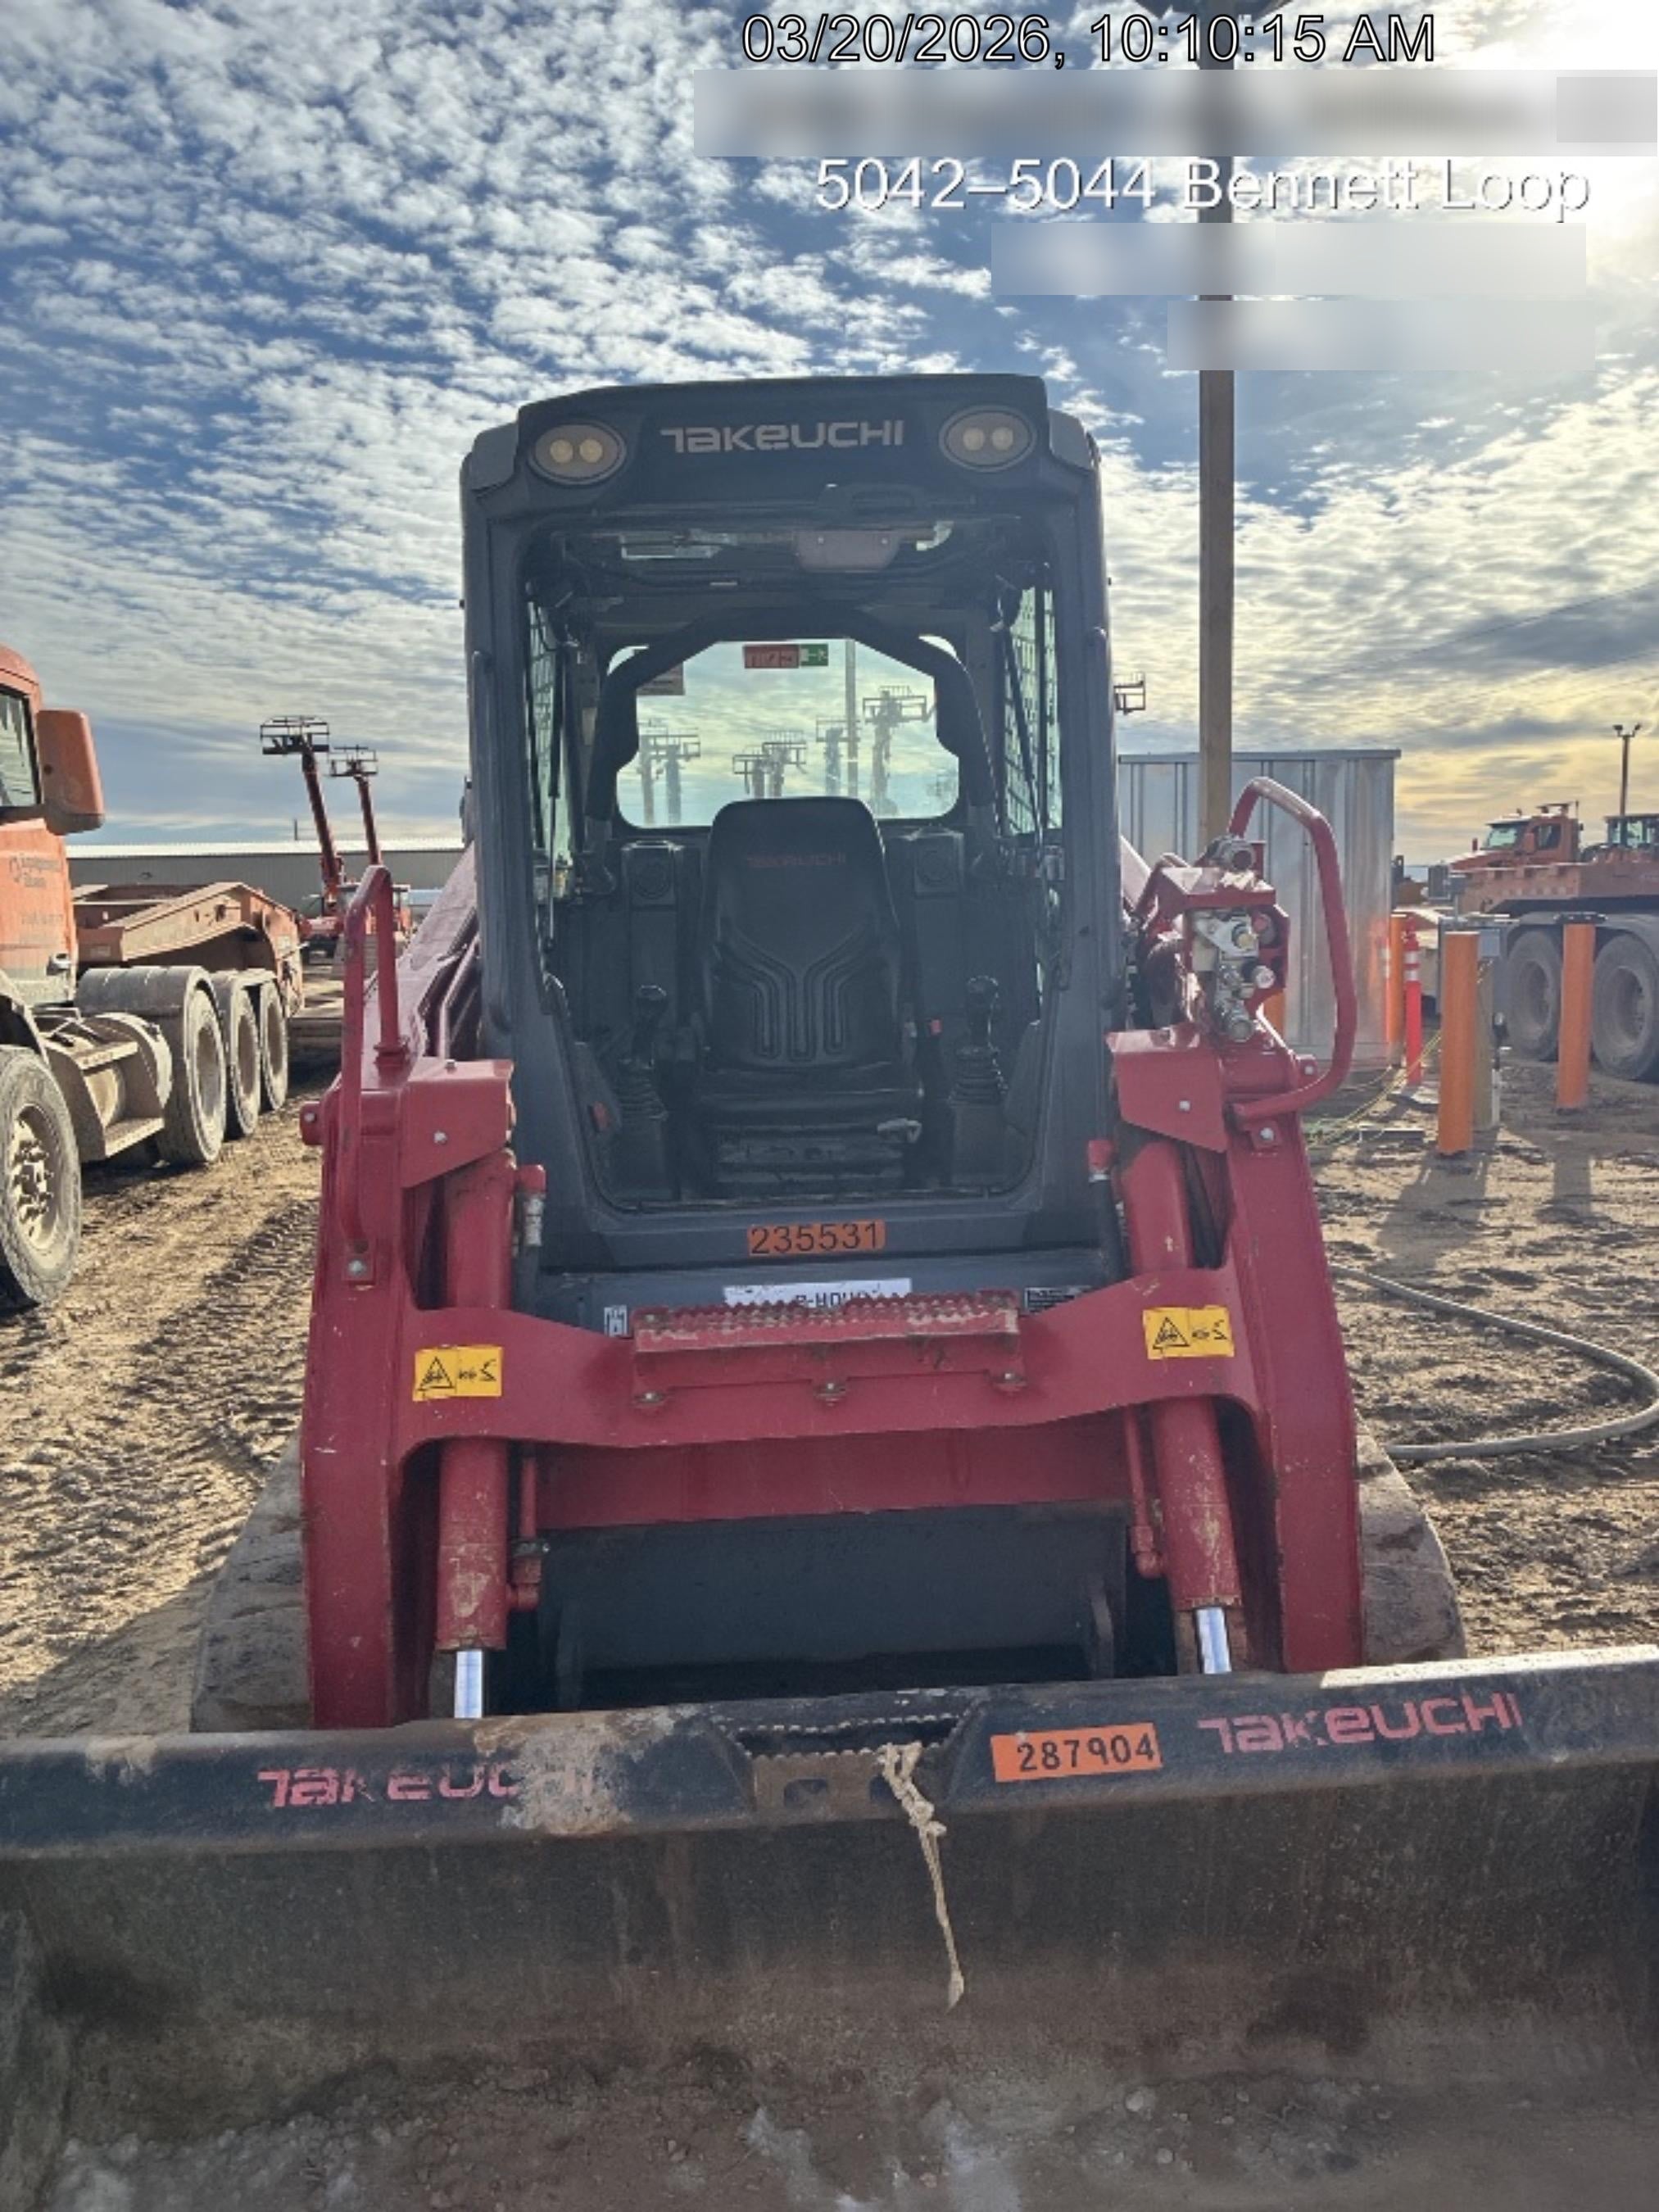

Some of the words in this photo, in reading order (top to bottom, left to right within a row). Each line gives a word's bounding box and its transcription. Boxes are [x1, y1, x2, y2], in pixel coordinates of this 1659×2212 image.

[660, 419, 904, 453] TAKEUCHI
[750, 1221, 878, 1254] 235531
[1197, 1691, 1522, 1753] TAKEUCHI
[1017, 1732, 1154, 1772] 287904
